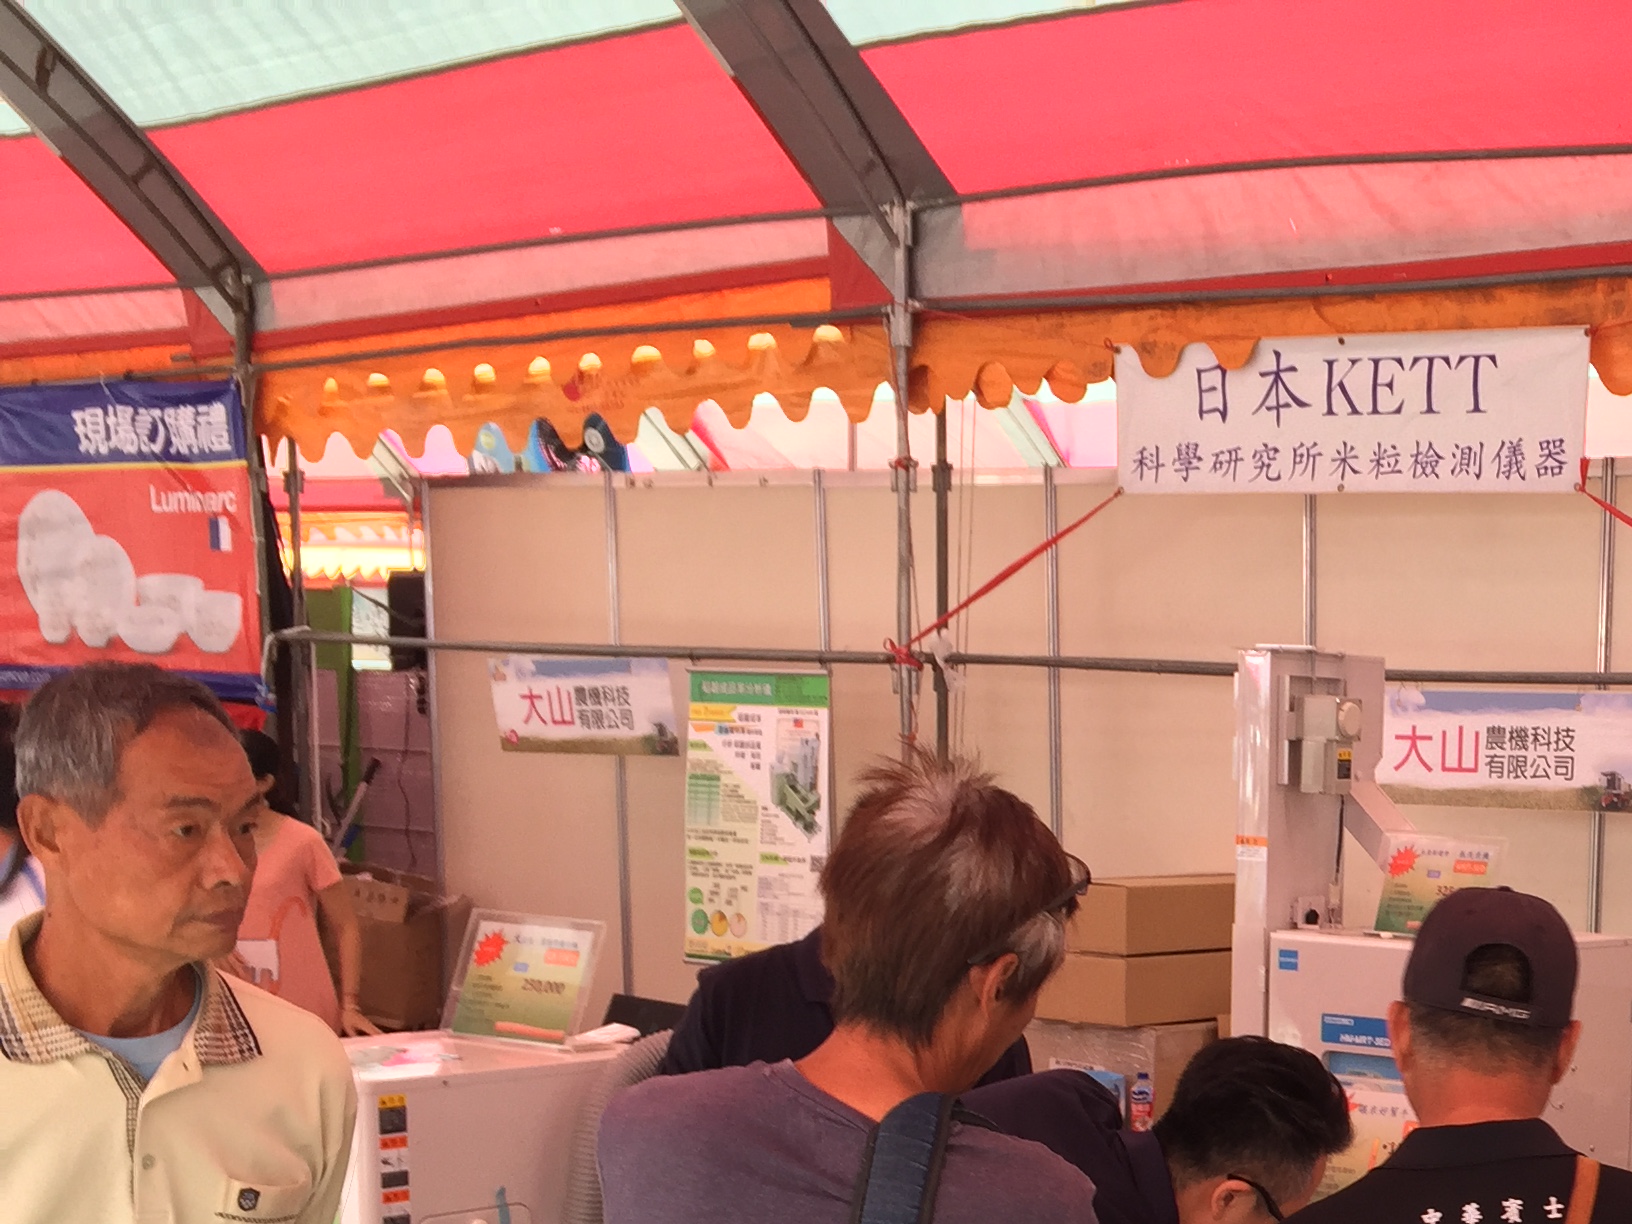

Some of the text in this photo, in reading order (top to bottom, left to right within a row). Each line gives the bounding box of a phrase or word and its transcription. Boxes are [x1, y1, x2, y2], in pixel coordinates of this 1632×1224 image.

[1194, 349, 1498, 428] 日本KETT
[71, 402, 232, 455] 現場訂購禮
[1131, 436, 1569, 484] 科學研究所米粒檢測儀器
[519, 685, 575, 726] 大山
[574, 684, 632, 707] 農機科技
[577, 707, 635, 731] 有限公司
[1484, 725, 1576, 752] 農機科技
[1393, 724, 1480, 773] 大山
[1484, 753, 1576, 781] 有限公司
